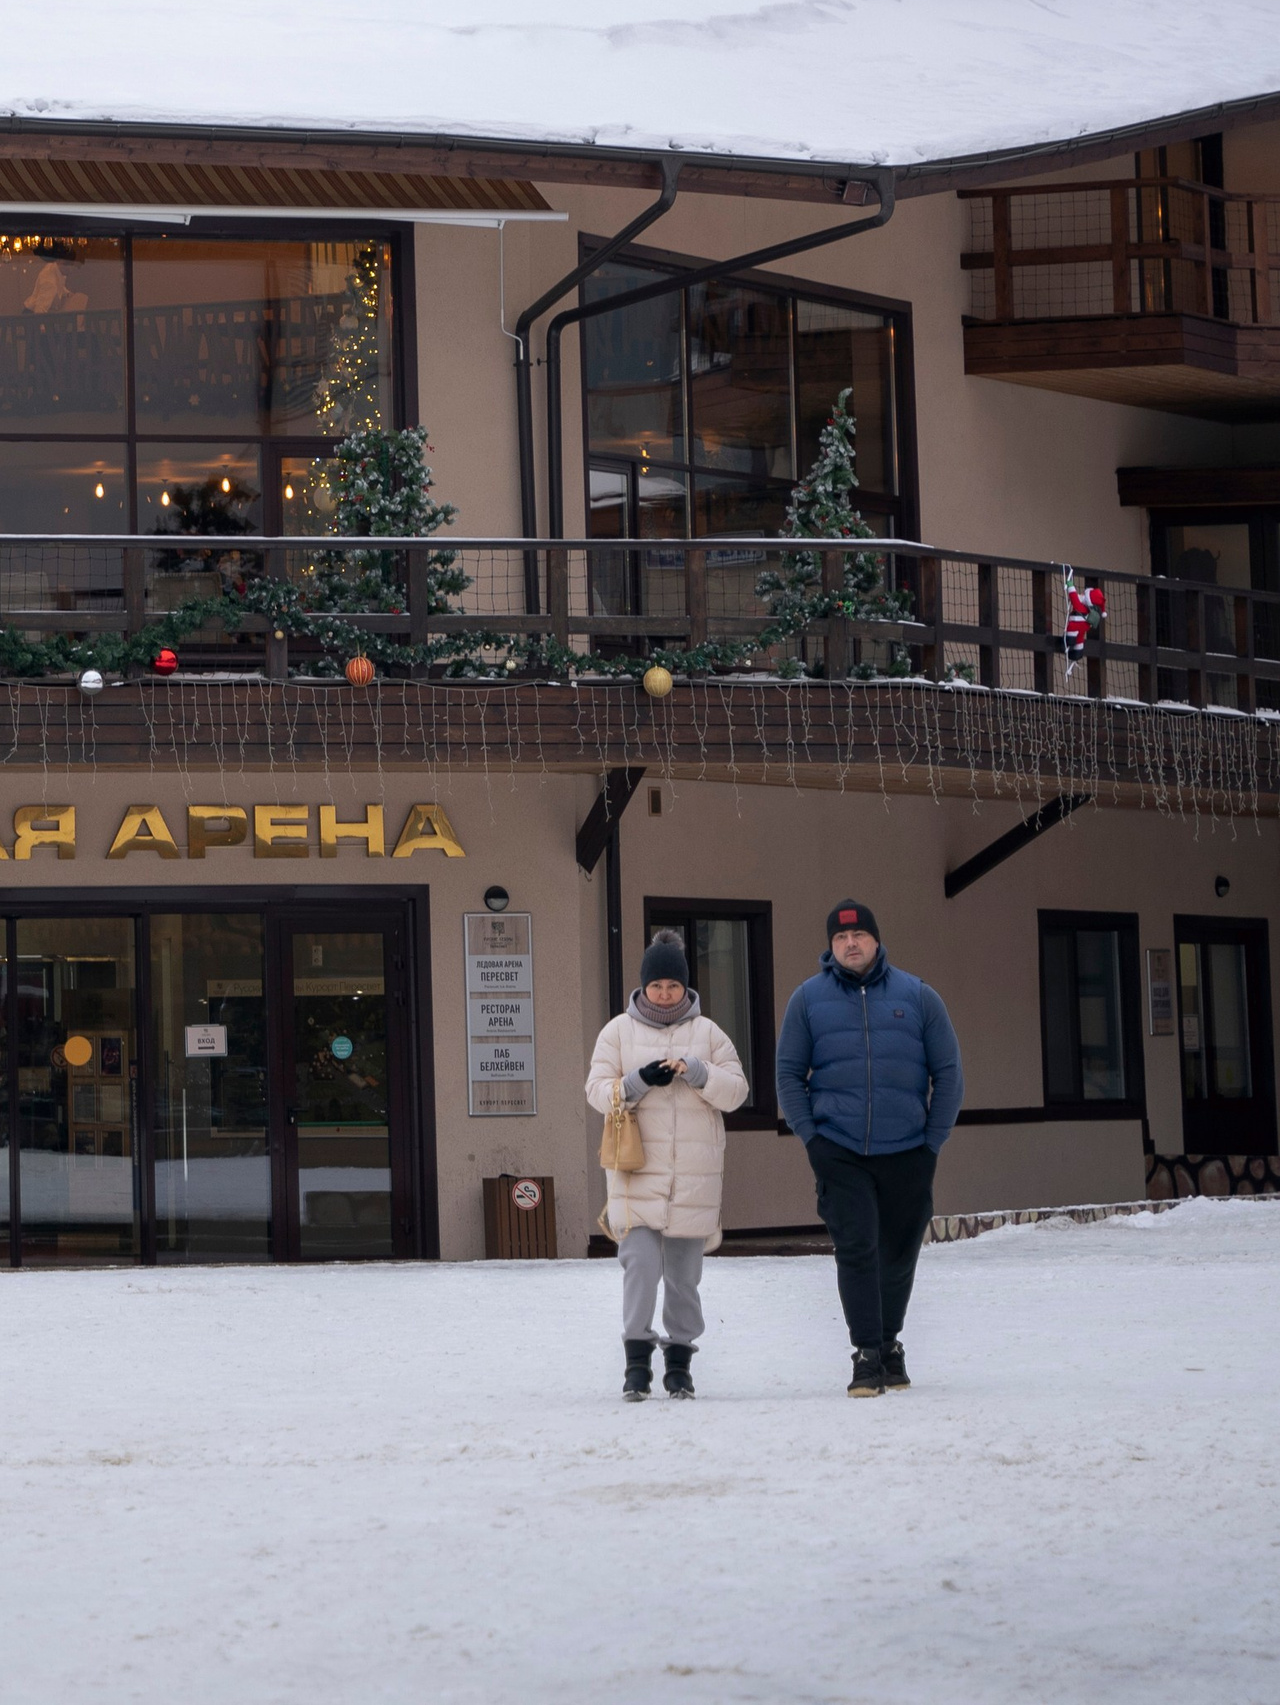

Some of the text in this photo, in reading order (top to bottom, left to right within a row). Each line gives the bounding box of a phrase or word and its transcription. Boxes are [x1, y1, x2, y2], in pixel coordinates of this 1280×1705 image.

[106, 803, 466, 860] АРЕНА
[476, 960, 523, 969] ЛЕДОВАЯ АРЕНА
[480, 971, 518, 982] ПЕРЕСВЕТ
[481, 1004, 520, 1014] РЕСТОРАН
[488, 1017, 514, 1027] АРЕНА
[494, 1048, 510, 1058] ПАБ
[480, 1060, 525, 1071] БЕЛХЕЙВЕН
